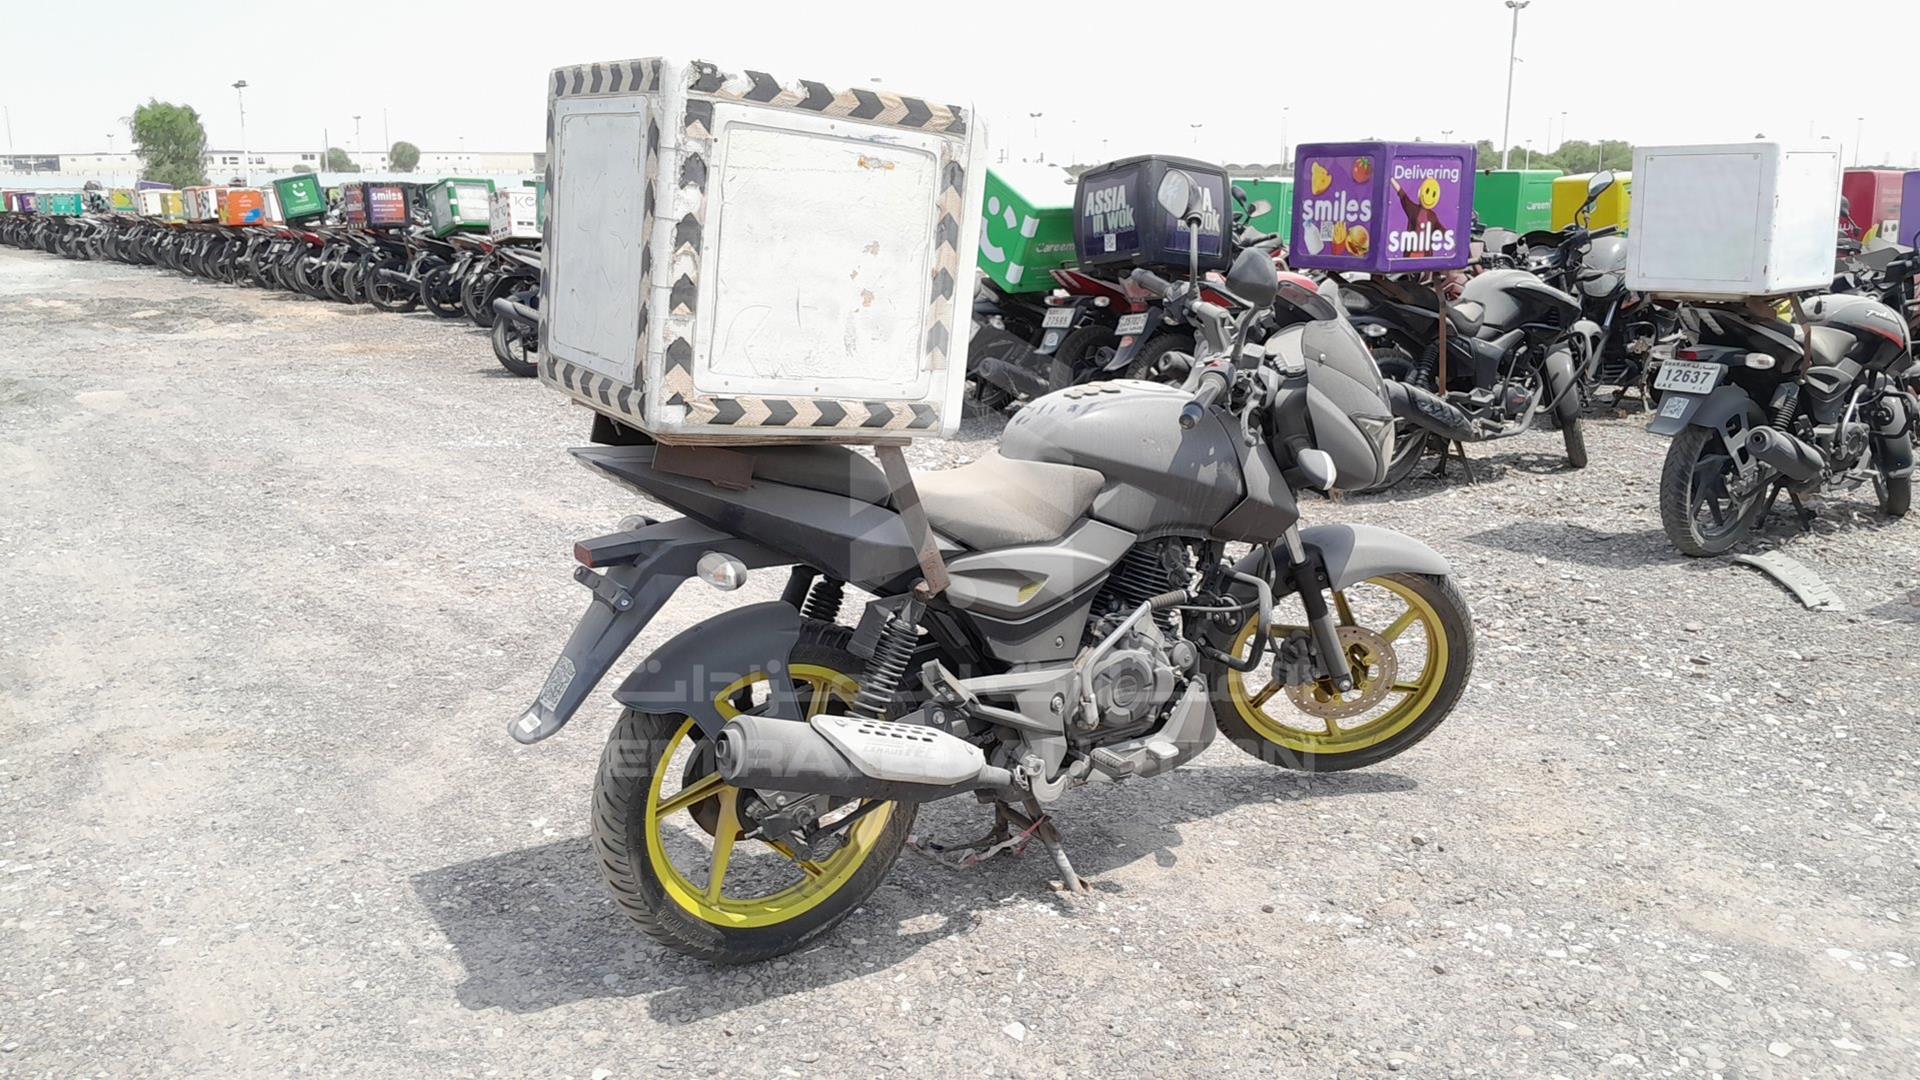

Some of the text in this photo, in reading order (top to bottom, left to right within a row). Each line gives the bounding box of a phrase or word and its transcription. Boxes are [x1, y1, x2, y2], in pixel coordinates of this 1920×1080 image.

[1394, 165, 1459, 183] Delivering
[371, 189, 403, 201] smiles
[1085, 185, 1126, 216] ASSIA
[1302, 190, 1372, 222] smiles
[1388, 221, 1456, 252] smiles
[1665, 368, 1711, 385] 12637
